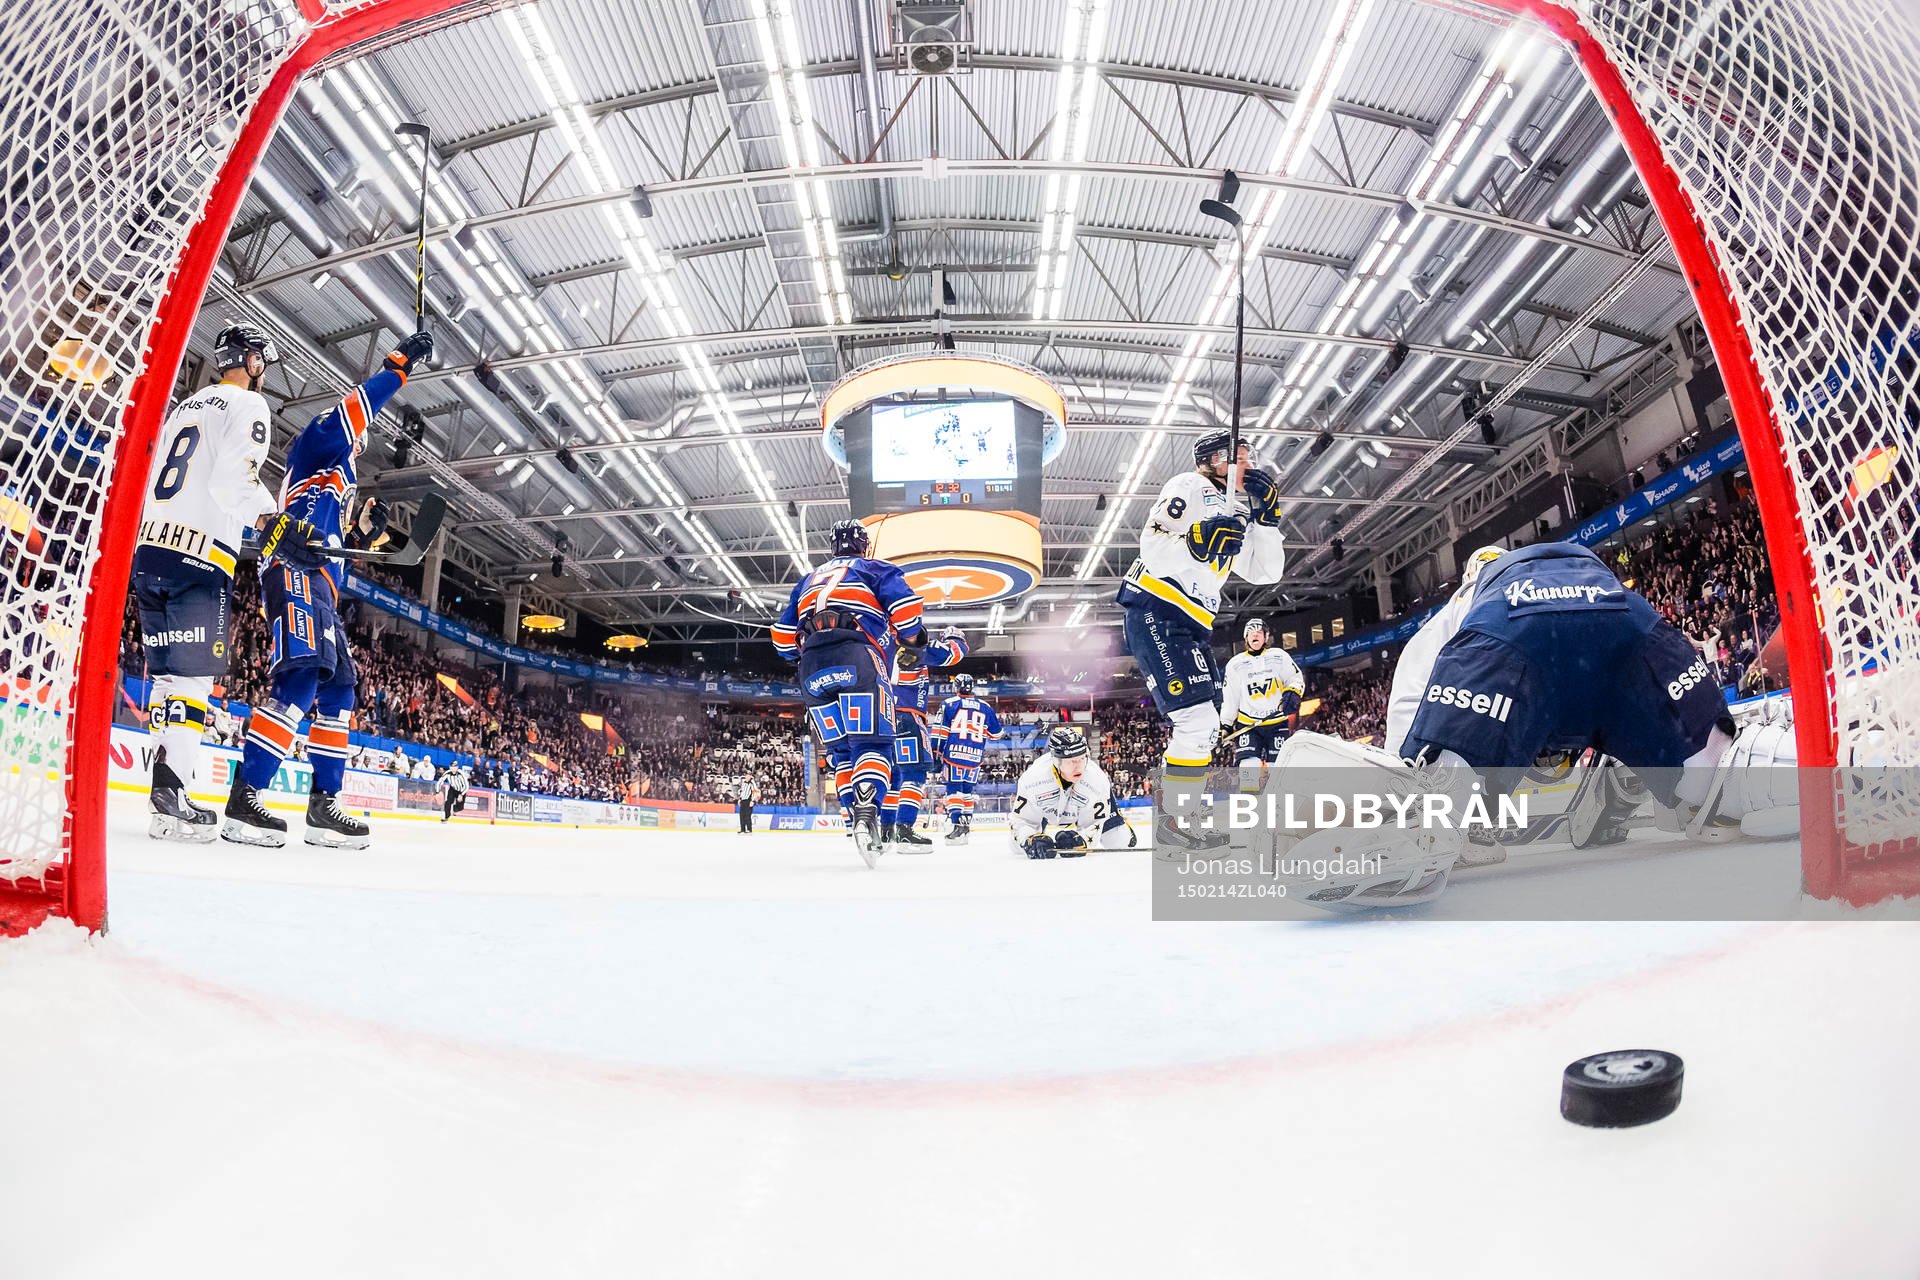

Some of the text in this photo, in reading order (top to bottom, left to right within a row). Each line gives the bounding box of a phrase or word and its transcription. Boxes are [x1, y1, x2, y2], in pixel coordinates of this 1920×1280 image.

[251, 421, 267, 444] 8
[154, 424, 201, 502] 8
[963, 493, 971, 504] 0
[1654, 482, 1679, 501] SHARP
[181, 556, 215, 573] BAUER
[810, 566, 849, 615] 7
[296, 609, 306, 638] ALWEX
[1149, 624, 1176, 677] Holmgrens
[1426, 684, 1513, 723] essell
[950, 708, 986, 743] 49
[497, 792, 531, 815] filtrena
